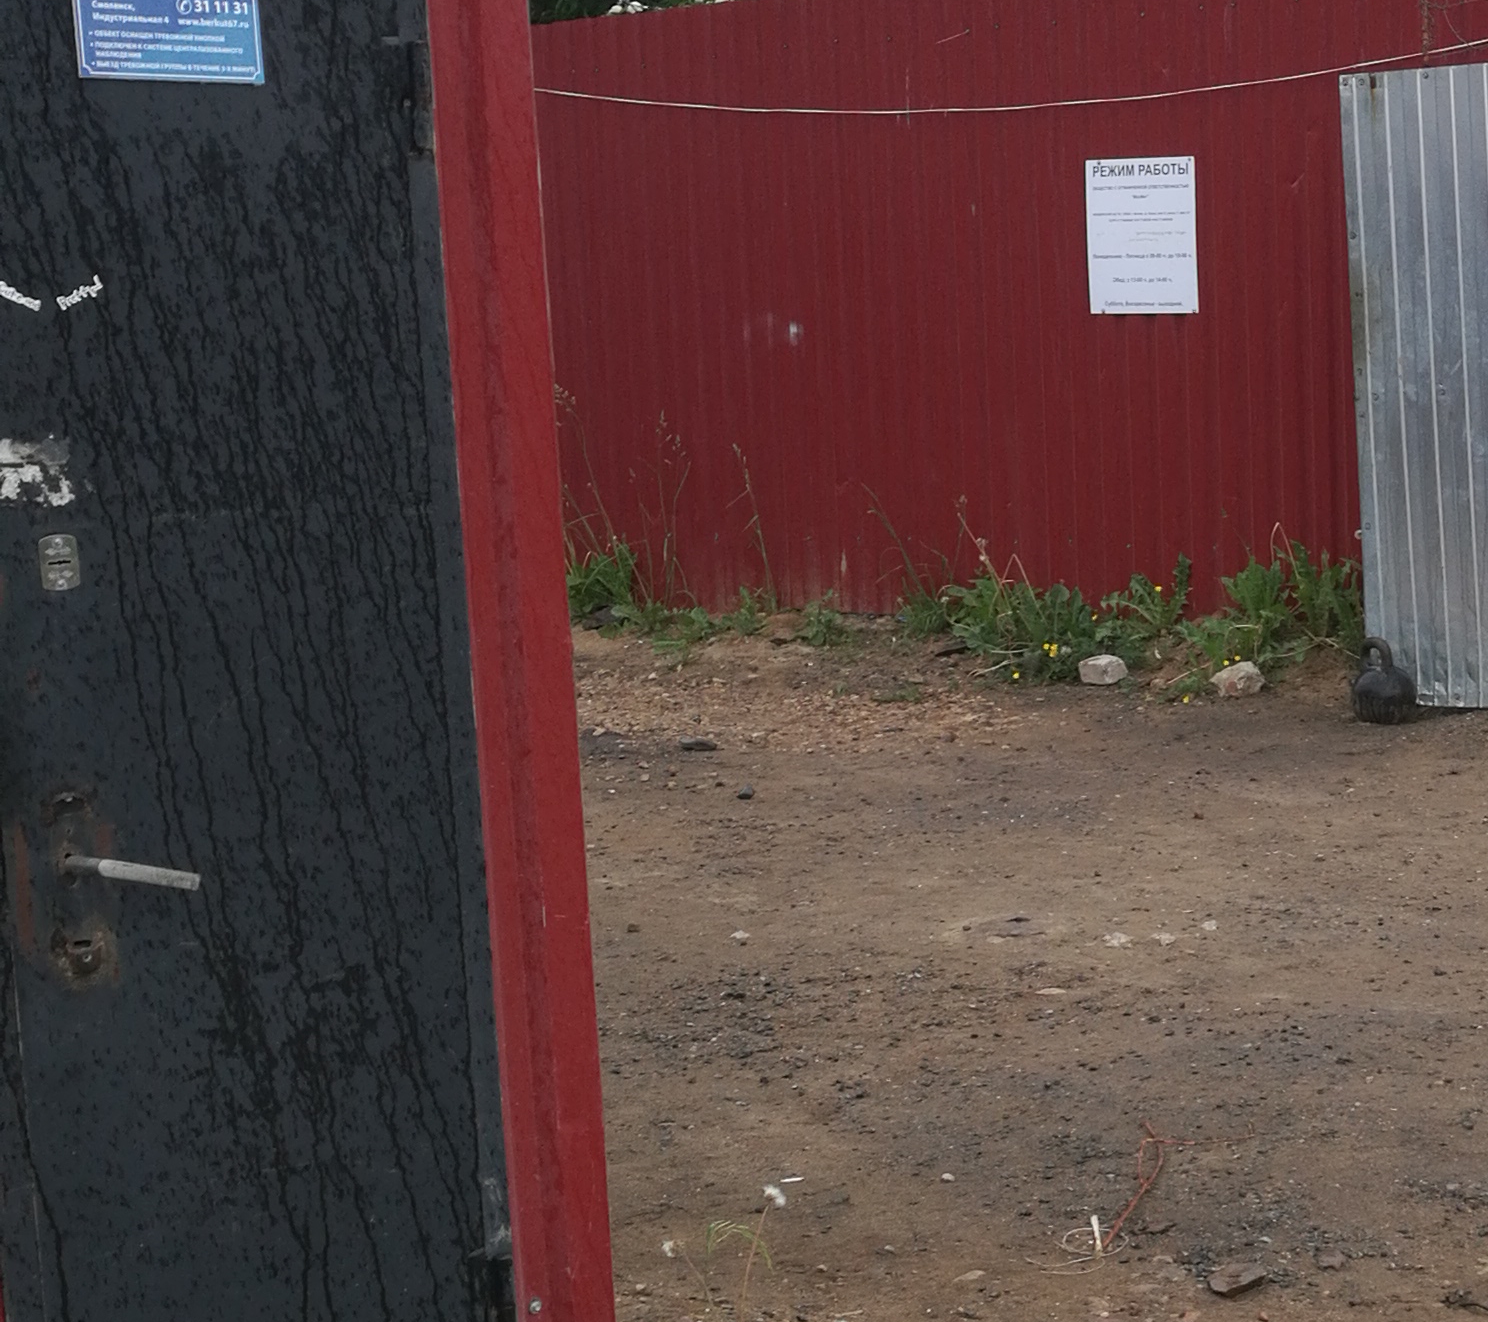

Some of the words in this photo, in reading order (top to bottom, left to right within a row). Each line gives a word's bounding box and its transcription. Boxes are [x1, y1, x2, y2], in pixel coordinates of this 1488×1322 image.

[193, 0, 210, 13] 31
[213, 0, 229, 14] 11
[233, 1, 249, 15] 31
[1092, 165, 1135, 177] РЕЖИМ
[1138, 162, 1189, 176] РАБОТЫ
